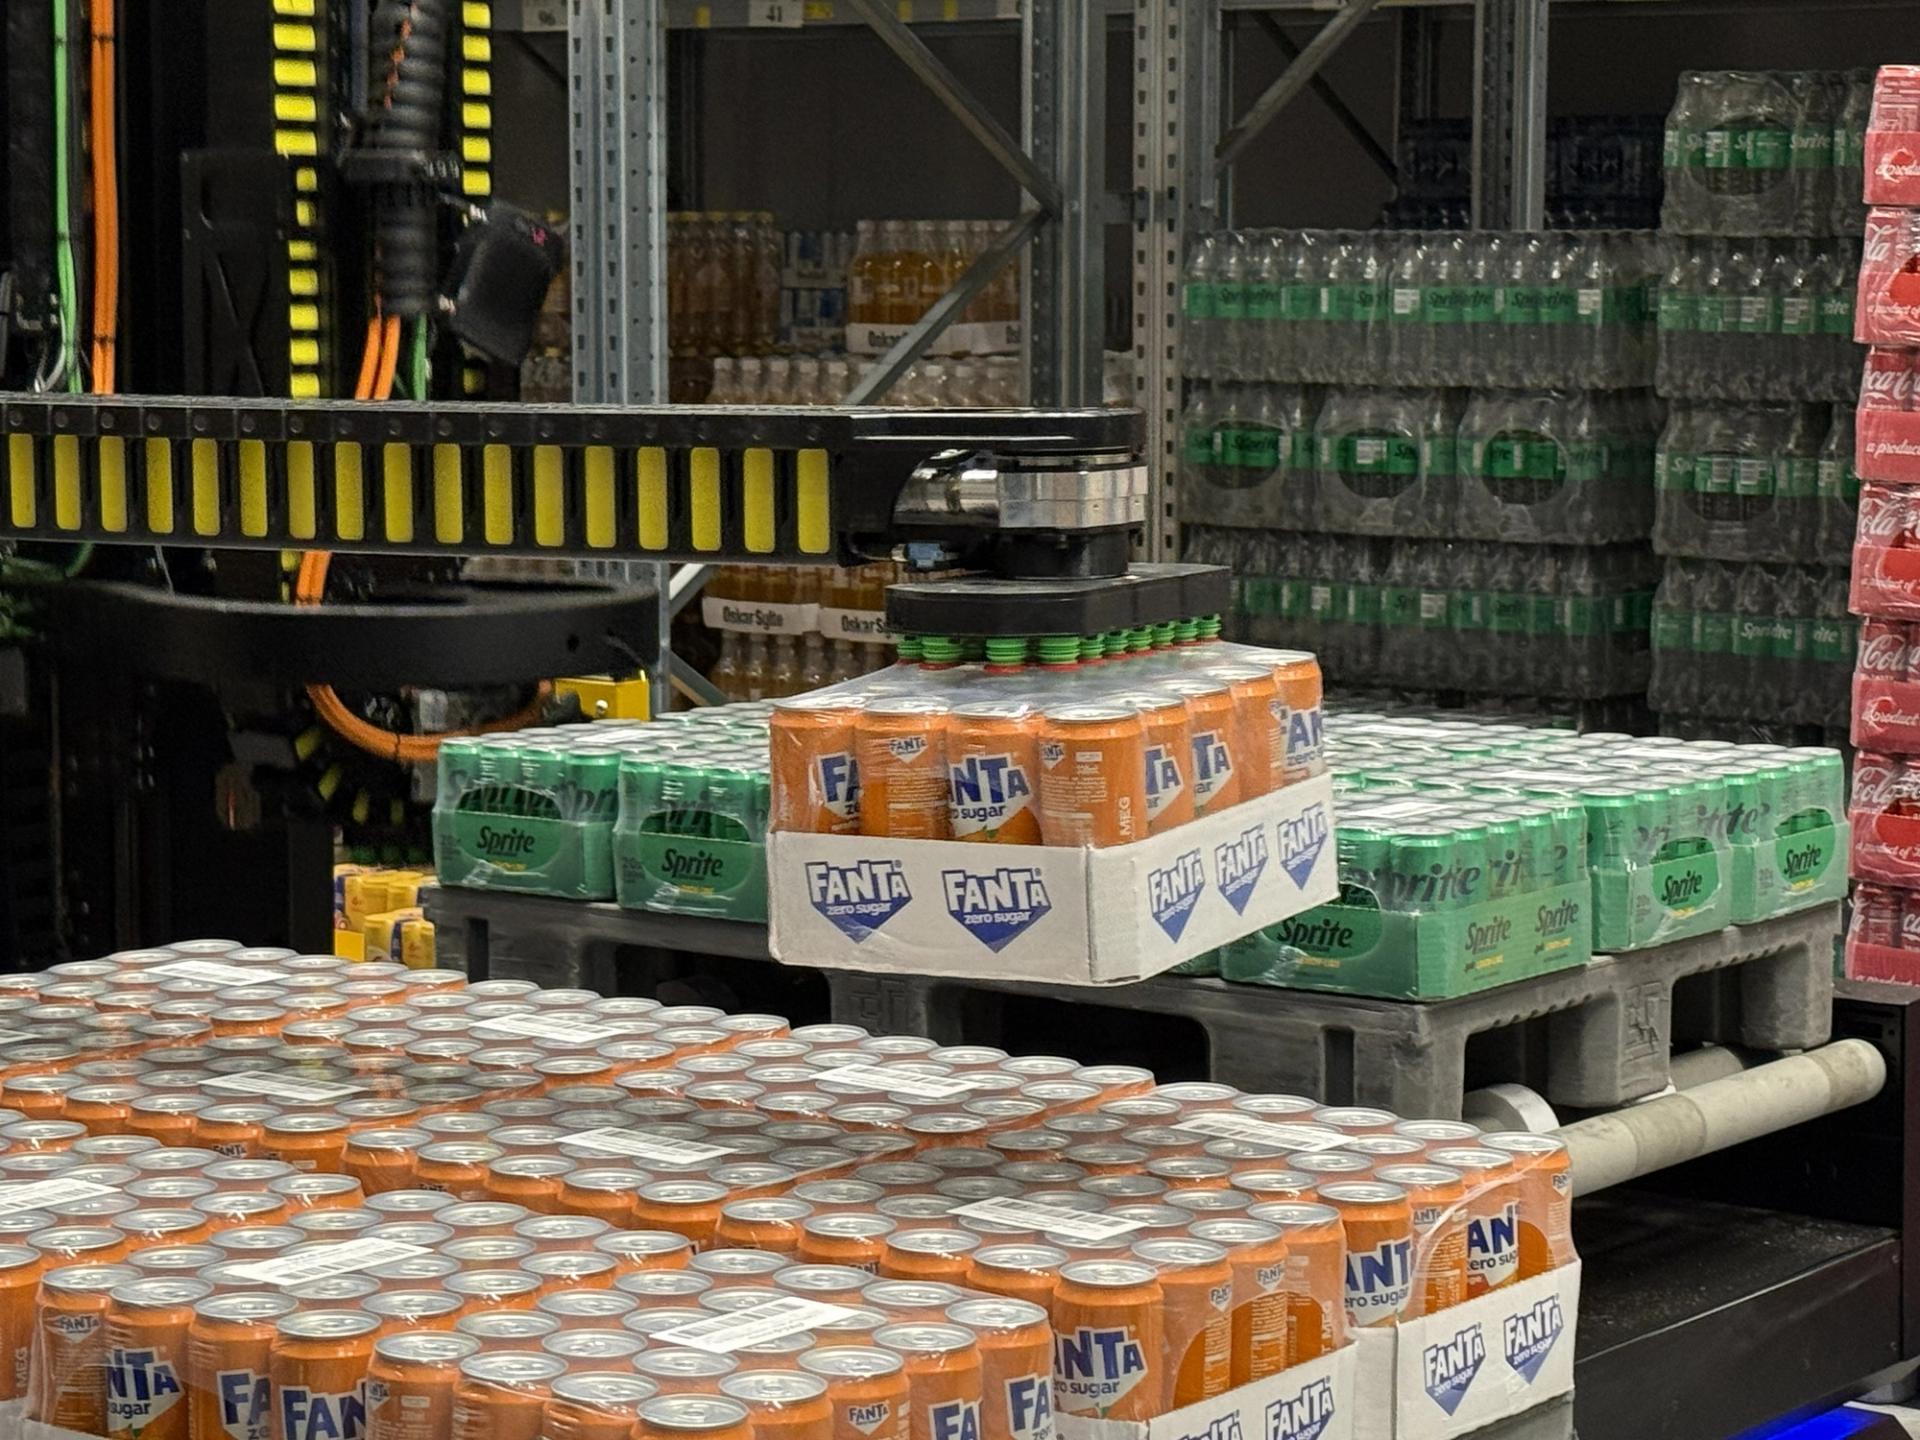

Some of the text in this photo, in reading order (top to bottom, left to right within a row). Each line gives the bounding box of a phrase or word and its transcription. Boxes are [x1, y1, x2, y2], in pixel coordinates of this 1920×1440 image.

[722, 606, 754, 624] Oskar
[951, 757, 1030, 806] NTA
[961, 806, 1007, 823] sugar
[1277, 804, 1328, 862] FANTA
[476, 826, 535, 853] Sprite
[1215, 827, 1268, 887] FANTA
[661, 848, 723, 878] Sprite
[1783, 845, 1822, 879] Sprite
[804, 860, 913, 904] FANTA
[942, 868, 1052, 913] FANTA
[1148, 850, 1205, 914] FANTA
[1661, 870, 1702, 905] Sprite
[826, 902, 893, 917] zero sugar
[964, 911, 1032, 925] zero sugar
[1535, 899, 1580, 938] Sprite
[1276, 917, 1354, 948] Sprite
[1465, 915, 1512, 955] Sprite
[1503, 1295, 1564, 1357] FANTA
[1055, 1331, 1144, 1380] NTA
[1423, 1324, 1486, 1387] FANTA
[1070, 1381, 1120, 1399] sugar
[1266, 1378, 1335, 1440] FANTA
